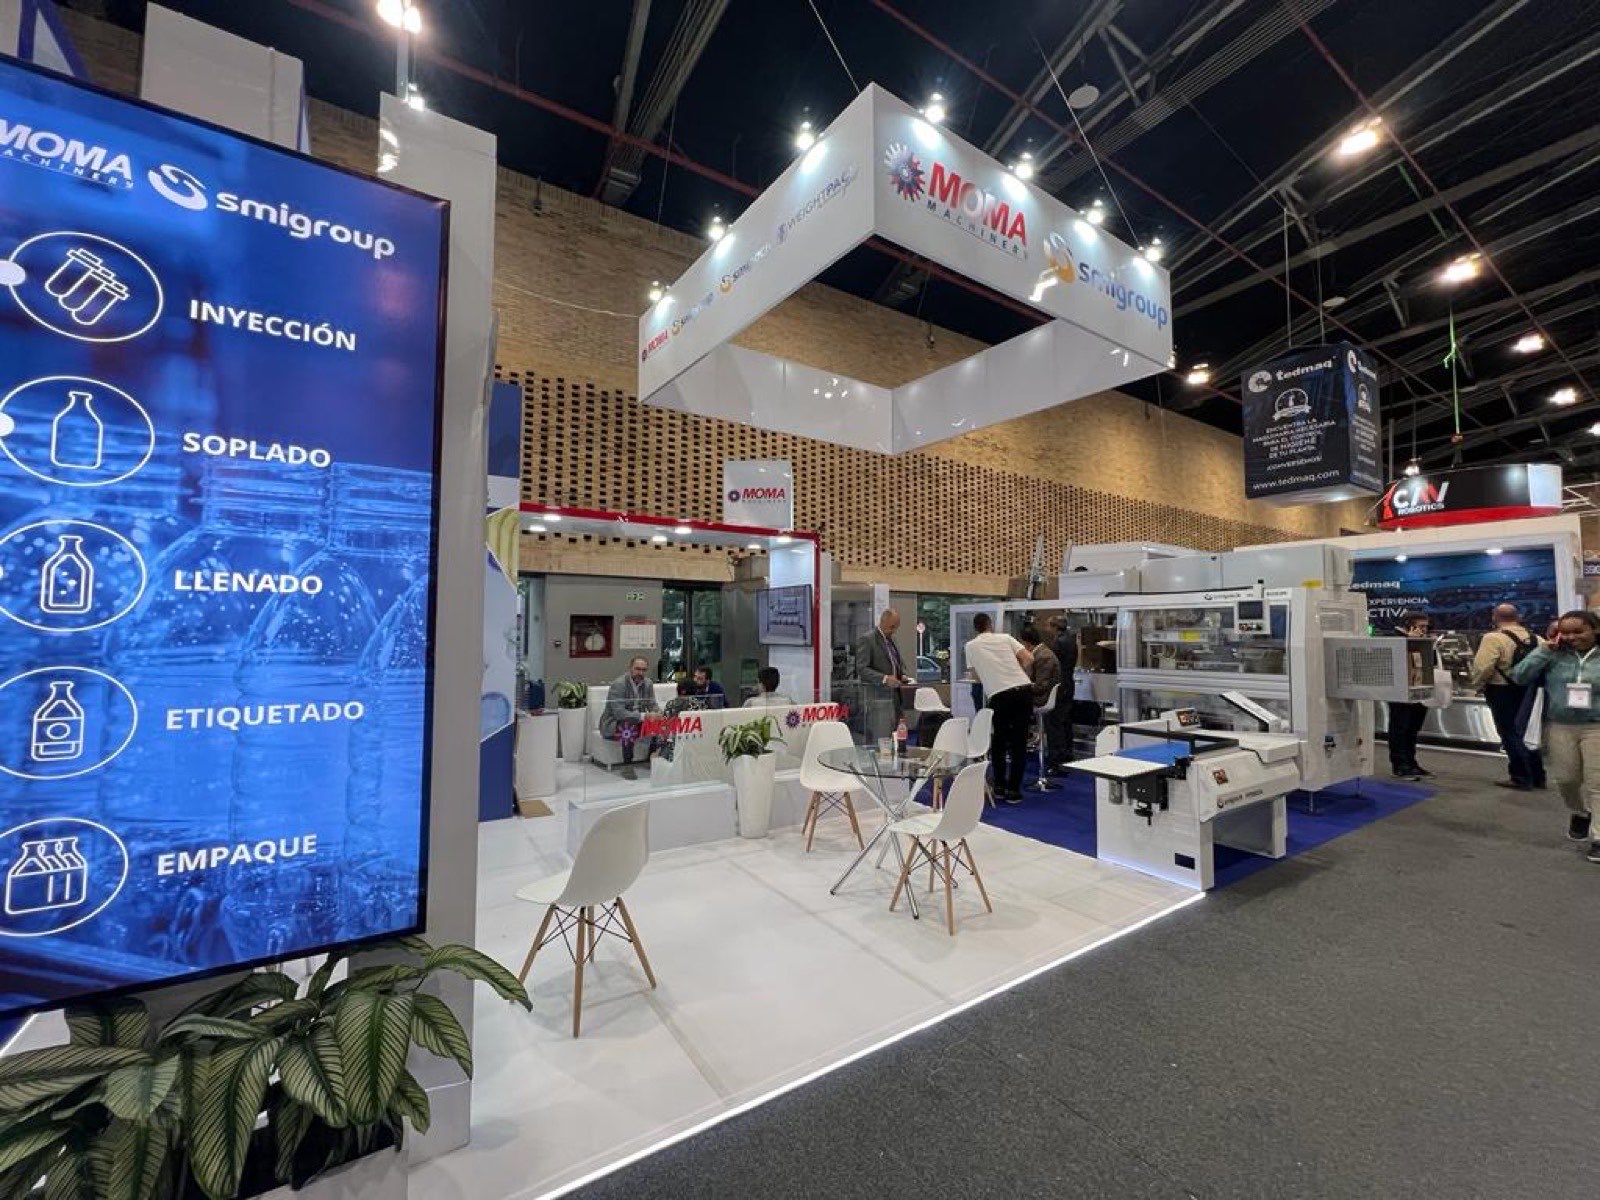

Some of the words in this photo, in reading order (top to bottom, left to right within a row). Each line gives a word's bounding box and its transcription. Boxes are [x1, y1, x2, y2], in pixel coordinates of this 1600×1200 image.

[0, 119, 132, 180] MOMA
[2, 149, 134, 189] ACHINERY
[928, 162, 1026, 247] MOMA
[216, 192, 396, 259] smigroup
[189, 299, 357, 352] INYECCIÓN
[182, 431, 331, 469] SOPLADO
[743, 487, 785, 499] MOMA
[1252, 469, 1340, 490] www.tedmaq.com
[174, 569, 324, 595] LLENADO
[1350, 580, 1401, 590] edmaq
[1367, 596, 1430, 606] XPERIENCIA
[1368, 606, 1409, 618] CTIVA
[165, 700, 365, 731] ETIQUETADO
[803, 703, 852, 723] MOMA
[157, 834, 318, 876] EMPAQUE
